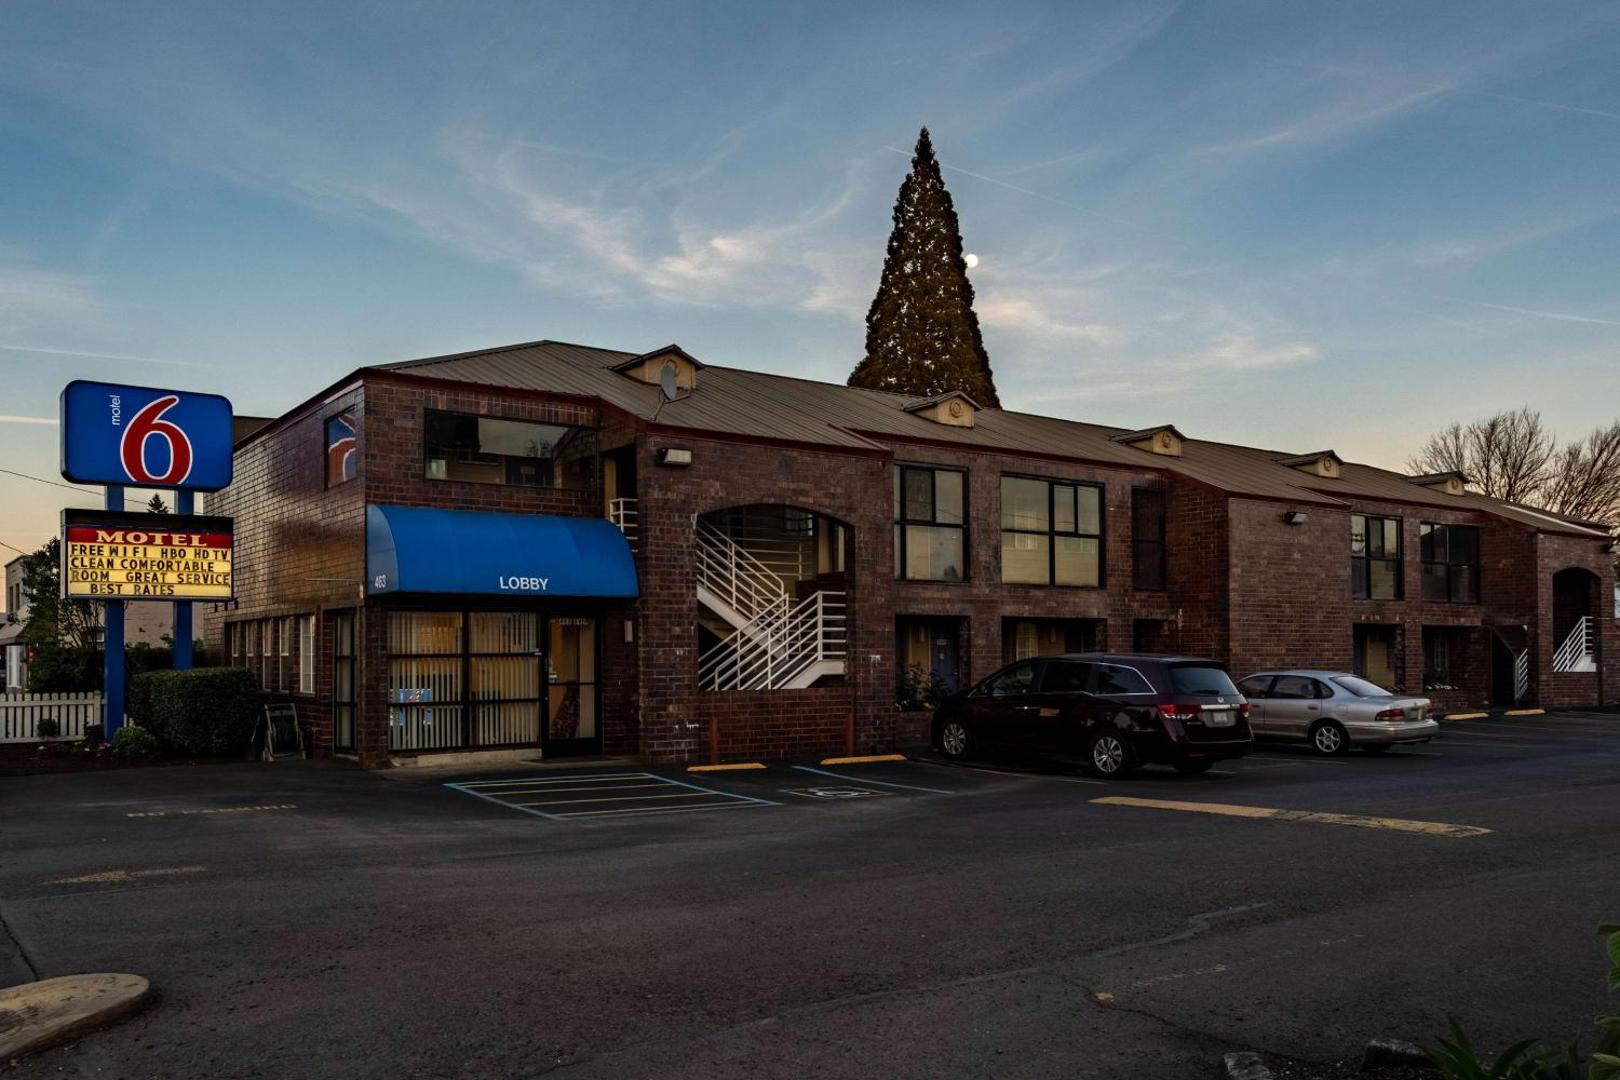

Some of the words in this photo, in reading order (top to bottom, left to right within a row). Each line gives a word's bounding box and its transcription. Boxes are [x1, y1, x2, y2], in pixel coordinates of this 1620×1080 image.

[110, 395, 120, 425] motel
[120, 395, 193, 485] 6
[96, 530, 207, 546] MOTEL
[71, 544, 104, 556] FREE
[161, 548, 186, 559] HBO
[71, 557, 114, 568] CLEAN
[121, 558, 214, 572] COMFORTABLE
[72, 570, 109, 582] ROOM
[126, 571, 166, 583] GREAT
[177, 573, 229, 584] SERVICE
[500, 576, 549, 591] LOBBY
[91, 583, 123, 595] BEST
[134, 584, 174, 595] RATES
